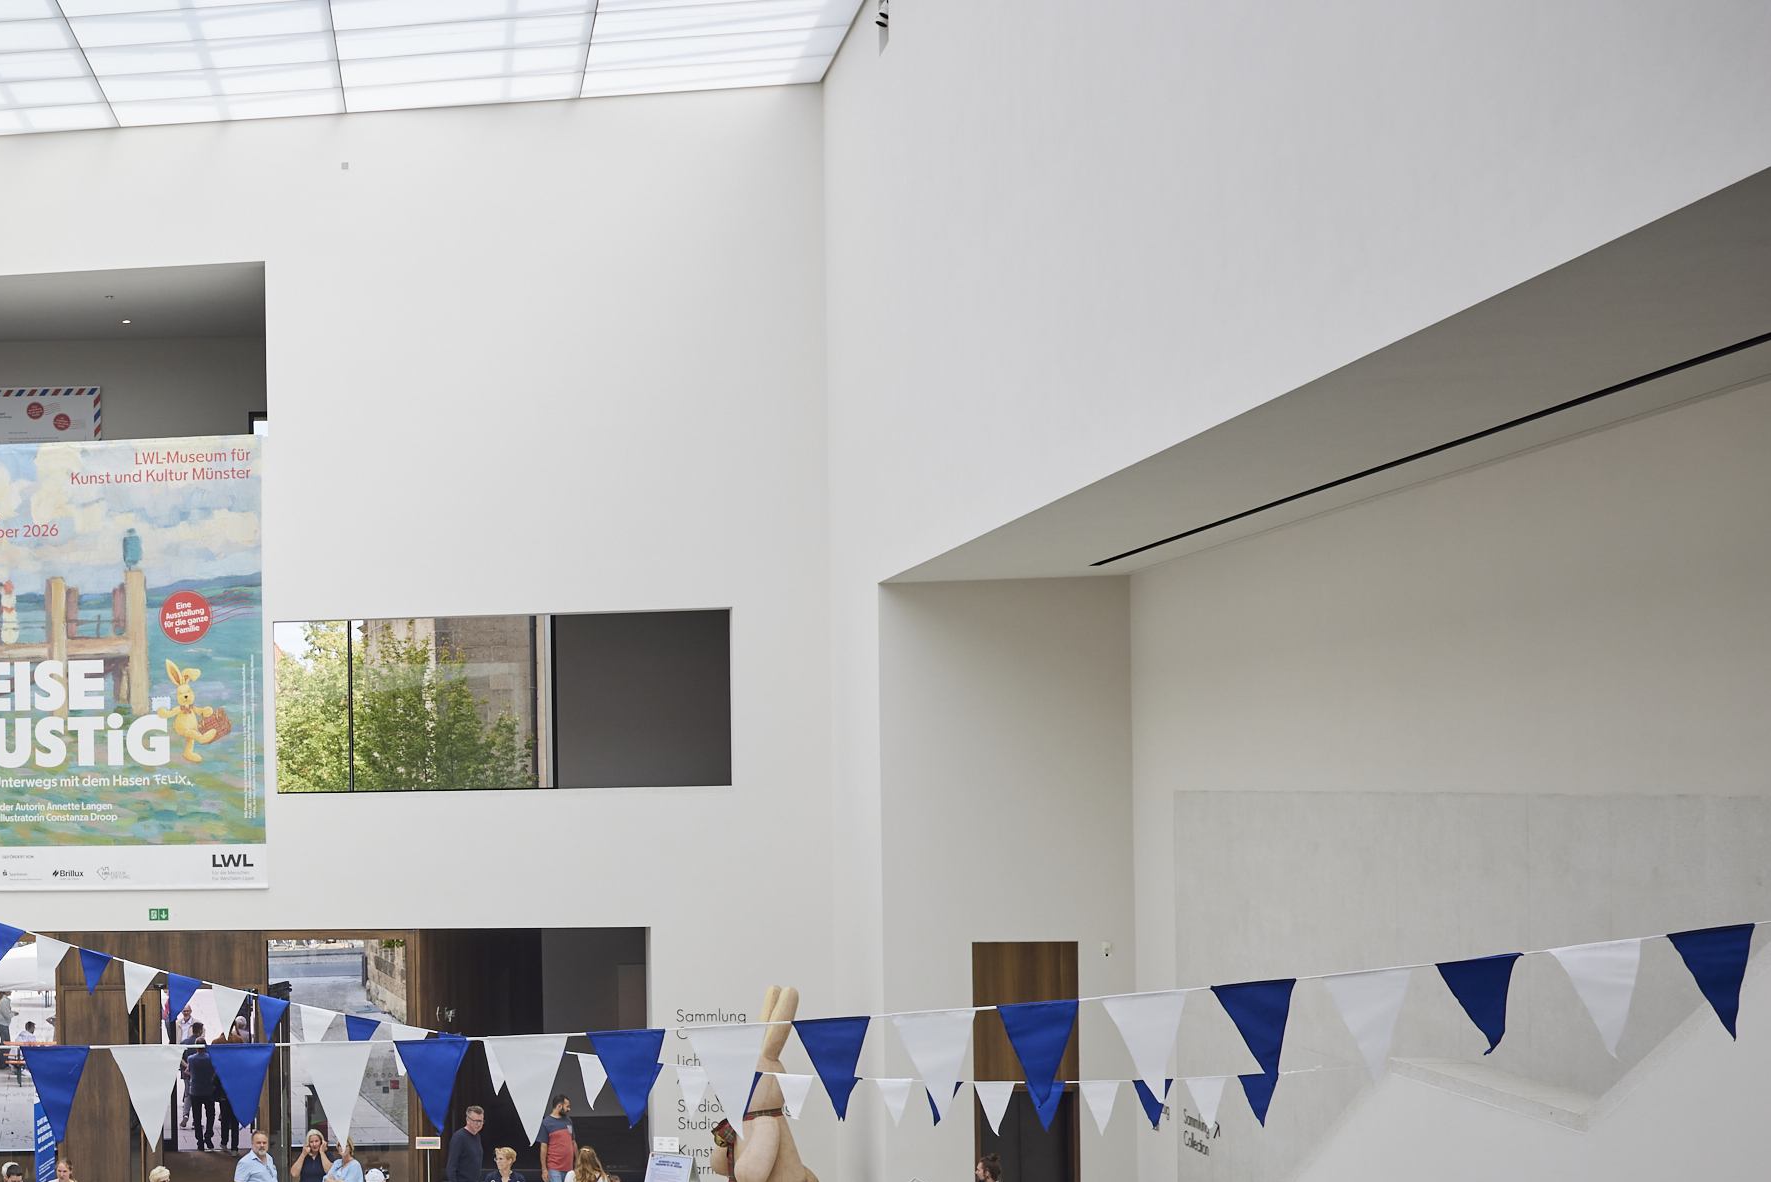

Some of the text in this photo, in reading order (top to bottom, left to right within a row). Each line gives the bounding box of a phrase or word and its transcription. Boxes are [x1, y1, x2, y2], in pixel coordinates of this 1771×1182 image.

[135, 448, 251, 465] LWL-Museum für
[70, 467, 251, 485] Kunst und Kultur Münster
[23, 524, 59, 538] 2026
[175, 602, 192, 610] Eine
[165, 608, 205, 620] Ausstellung
[164, 615, 209, 628] für die ganze
[174, 625, 200, 634] Familie
[59, 775, 80, 788] mit
[81, 775, 110, 787] dem
[112, 775, 151, 787] Hasen
[1, 802, 14, 812] der
[15, 802, 45, 811] Autorin
[46, 802, 80, 811] Annette
[81, 801, 113, 813] Langen
[45, 812, 89, 822] Constanza
[90, 812, 118, 824] Droop
[212, 853, 254, 868] LWL
[676, 1008, 747, 1024] Sammlung
[1184, 1130, 1210, 1156] Collection
